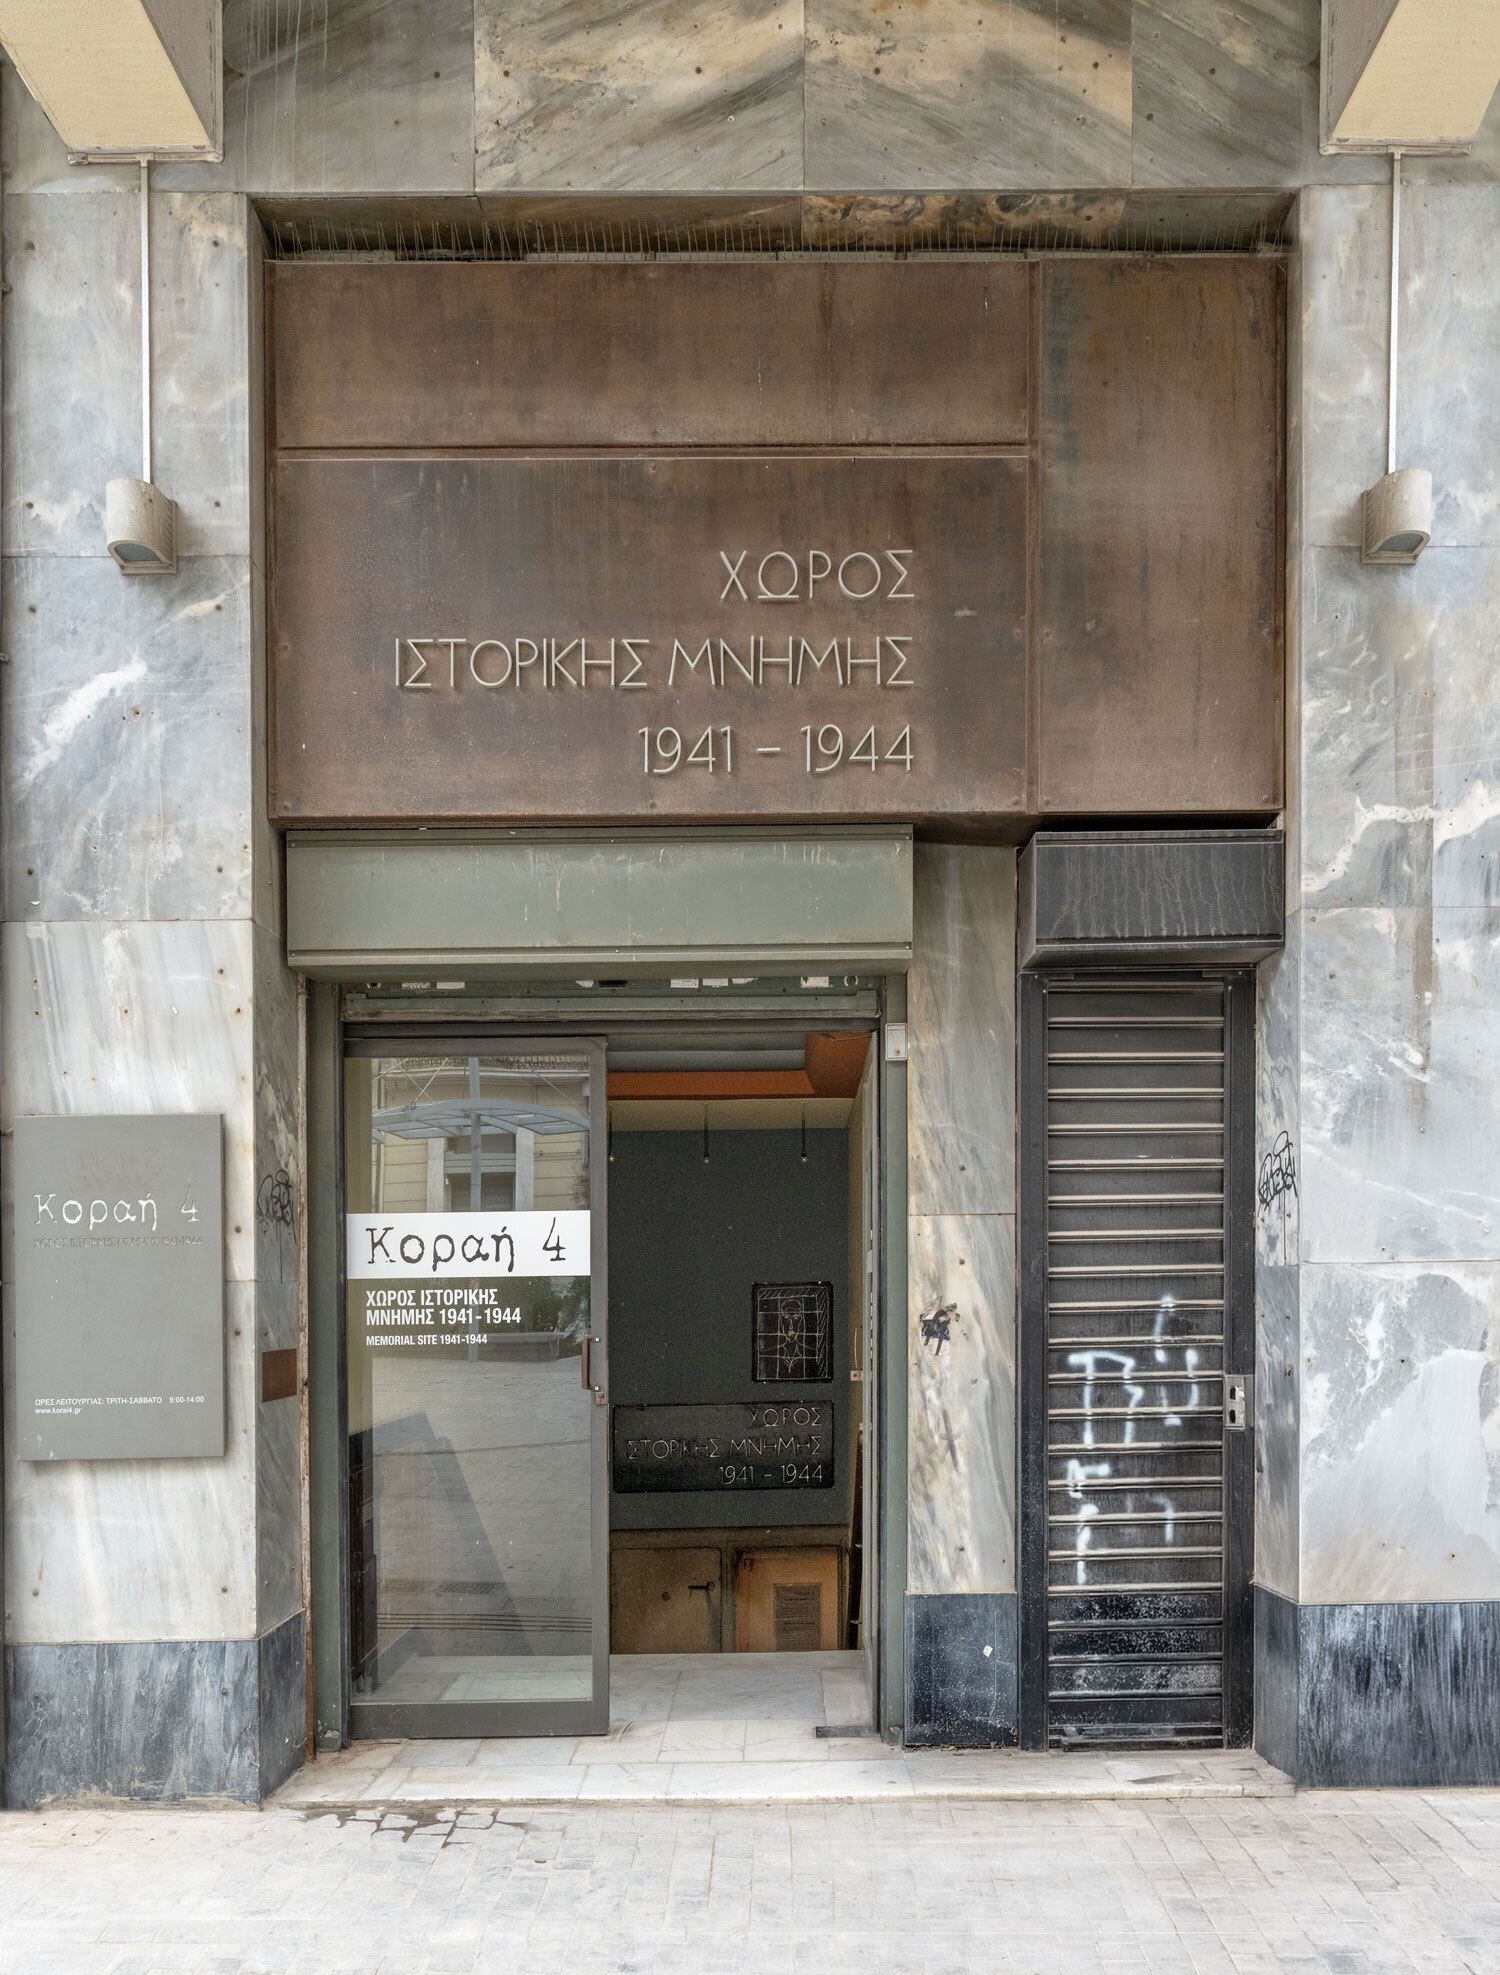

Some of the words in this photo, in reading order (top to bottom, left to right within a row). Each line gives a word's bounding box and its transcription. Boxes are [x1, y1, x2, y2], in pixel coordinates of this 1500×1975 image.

[719, 549, 915, 601] ΧΩΡΟΣ
[394, 637, 650, 688] ΙΣΤΟΡΙΚΗΣ
[668, 635, 914, 687] ΜΝΗΜΗΣ
[638, 725, 732, 775] 1941
[799, 723, 914, 774] 1944
[33, 1193, 157, 1231] Κοραή
[180, 1183, 201, 1222] 4
[365, 1226, 515, 1273] Κοραή
[542, 1216, 567, 1262] 4
[365, 1289, 417, 1307] ΧΩΡΟΣ
[419, 1288, 499, 1306] ΙΣΤΟΡΙΚΗΣ
[365, 1308, 435, 1326] ΜΝΗΜΗΣ
[365, 1334, 416, 1347] MEMORIAL
[417, 1334, 439, 1346] SITE
[439, 1333, 488, 1345] 1941-1944
[34, 1398, 56, 1406] ΩΡΕΣ
[169, 1395, 205, 1404] 9:00-14:00
[34, 1405, 82, 1415] www.korai4.gr
[750, 1407, 822, 1427] ΧΩΡΟΣ
[730, 1436, 822, 1456] ΜΝΗΜΗΣ
[719, 1465, 753, 1485] 1941
[781, 1463, 823, 1484] 1944
